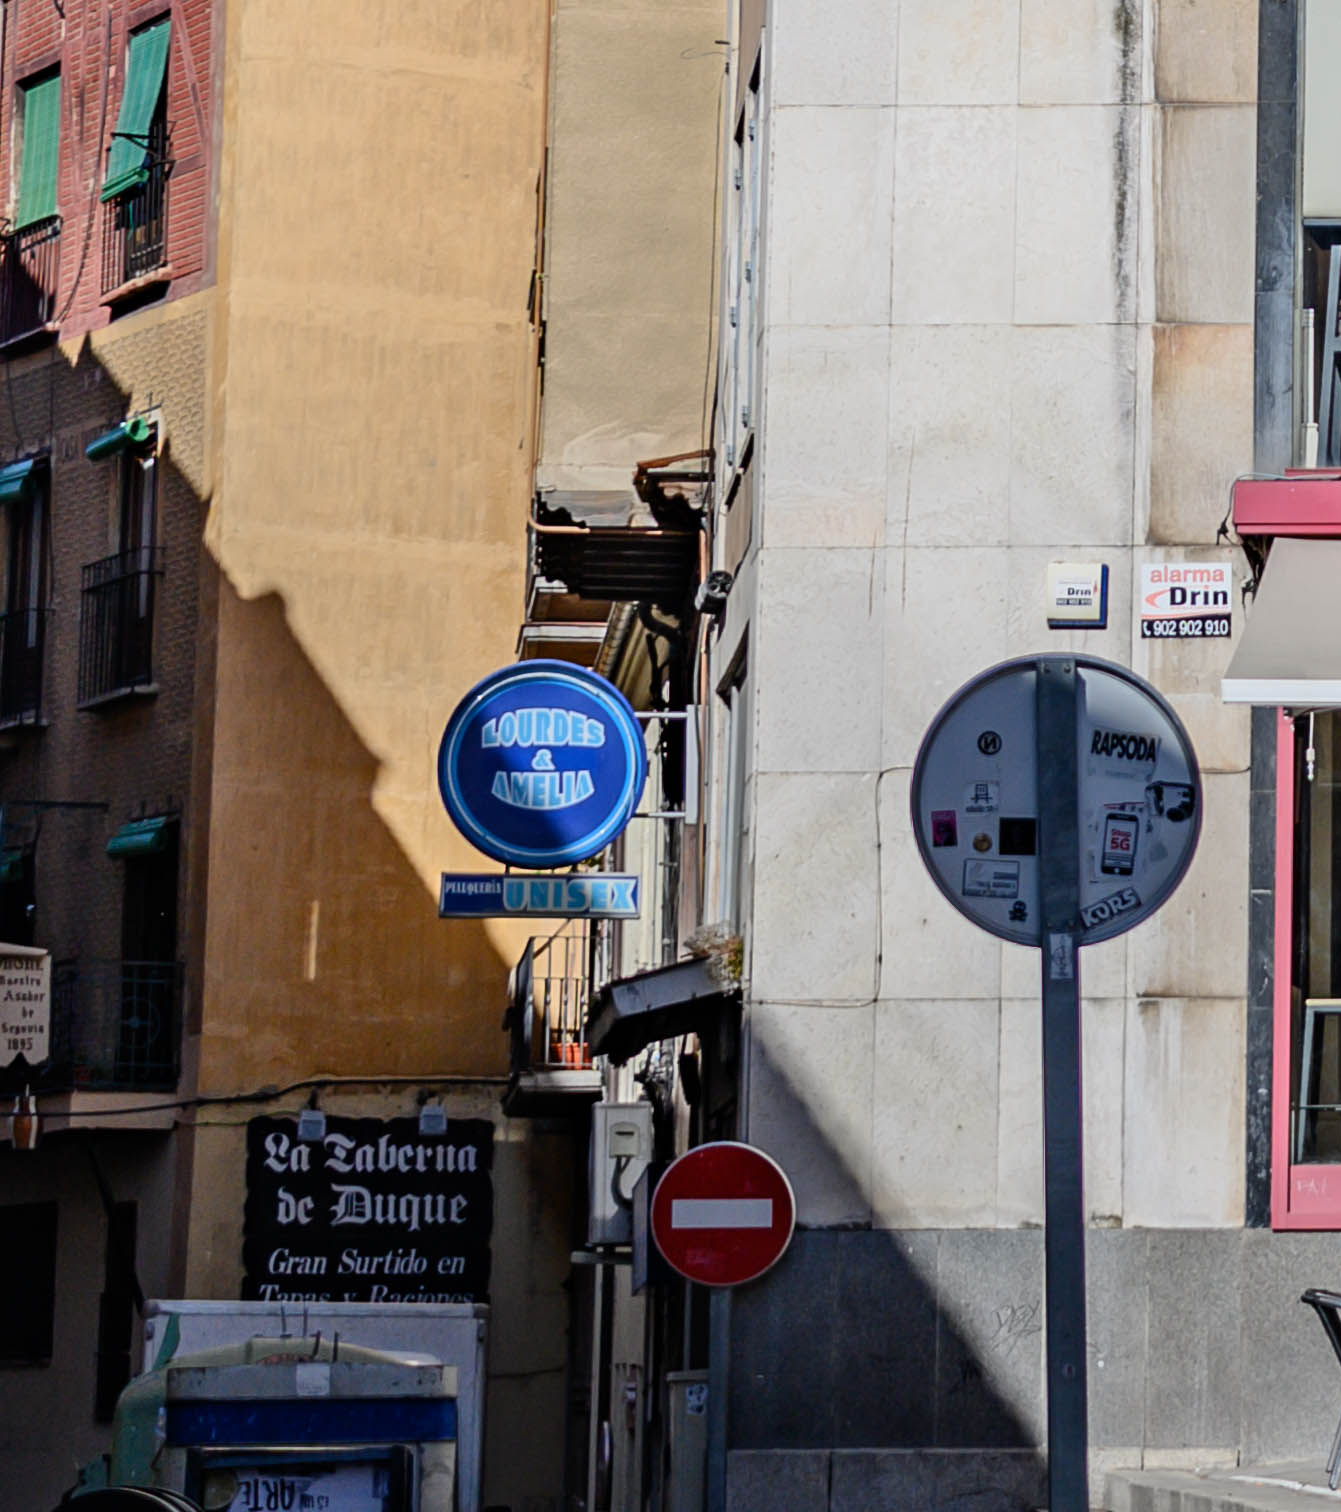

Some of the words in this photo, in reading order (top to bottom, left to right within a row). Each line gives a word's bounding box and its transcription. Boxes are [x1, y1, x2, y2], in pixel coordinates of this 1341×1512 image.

[1151, 566, 1224, 583] alarma
[1169, 585, 1228, 606] Drin
[1153, 621, 1176, 636] 902
[1179, 620, 1202, 636] 902
[1205, 620, 1228, 636] 910
[481, 708, 606, 748] LOURDES
[531, 748, 555, 771] &
[491, 770, 594, 810] AMELIA
[1111, 837, 1130, 850] 5G
[503, 877, 637, 914] UNISEX
[264, 1132, 312, 1173] La
[324, 1132, 478, 1173] Taberna
[277, 1185, 314, 1225] de
[329, 1182, 468, 1232] Duque
[269, 1247, 327, 1275] Gran
[338, 1247, 427, 1275] Surtido
[437, 1256, 465, 1275] en
[239, 1478, 295, 1512] ARTE
